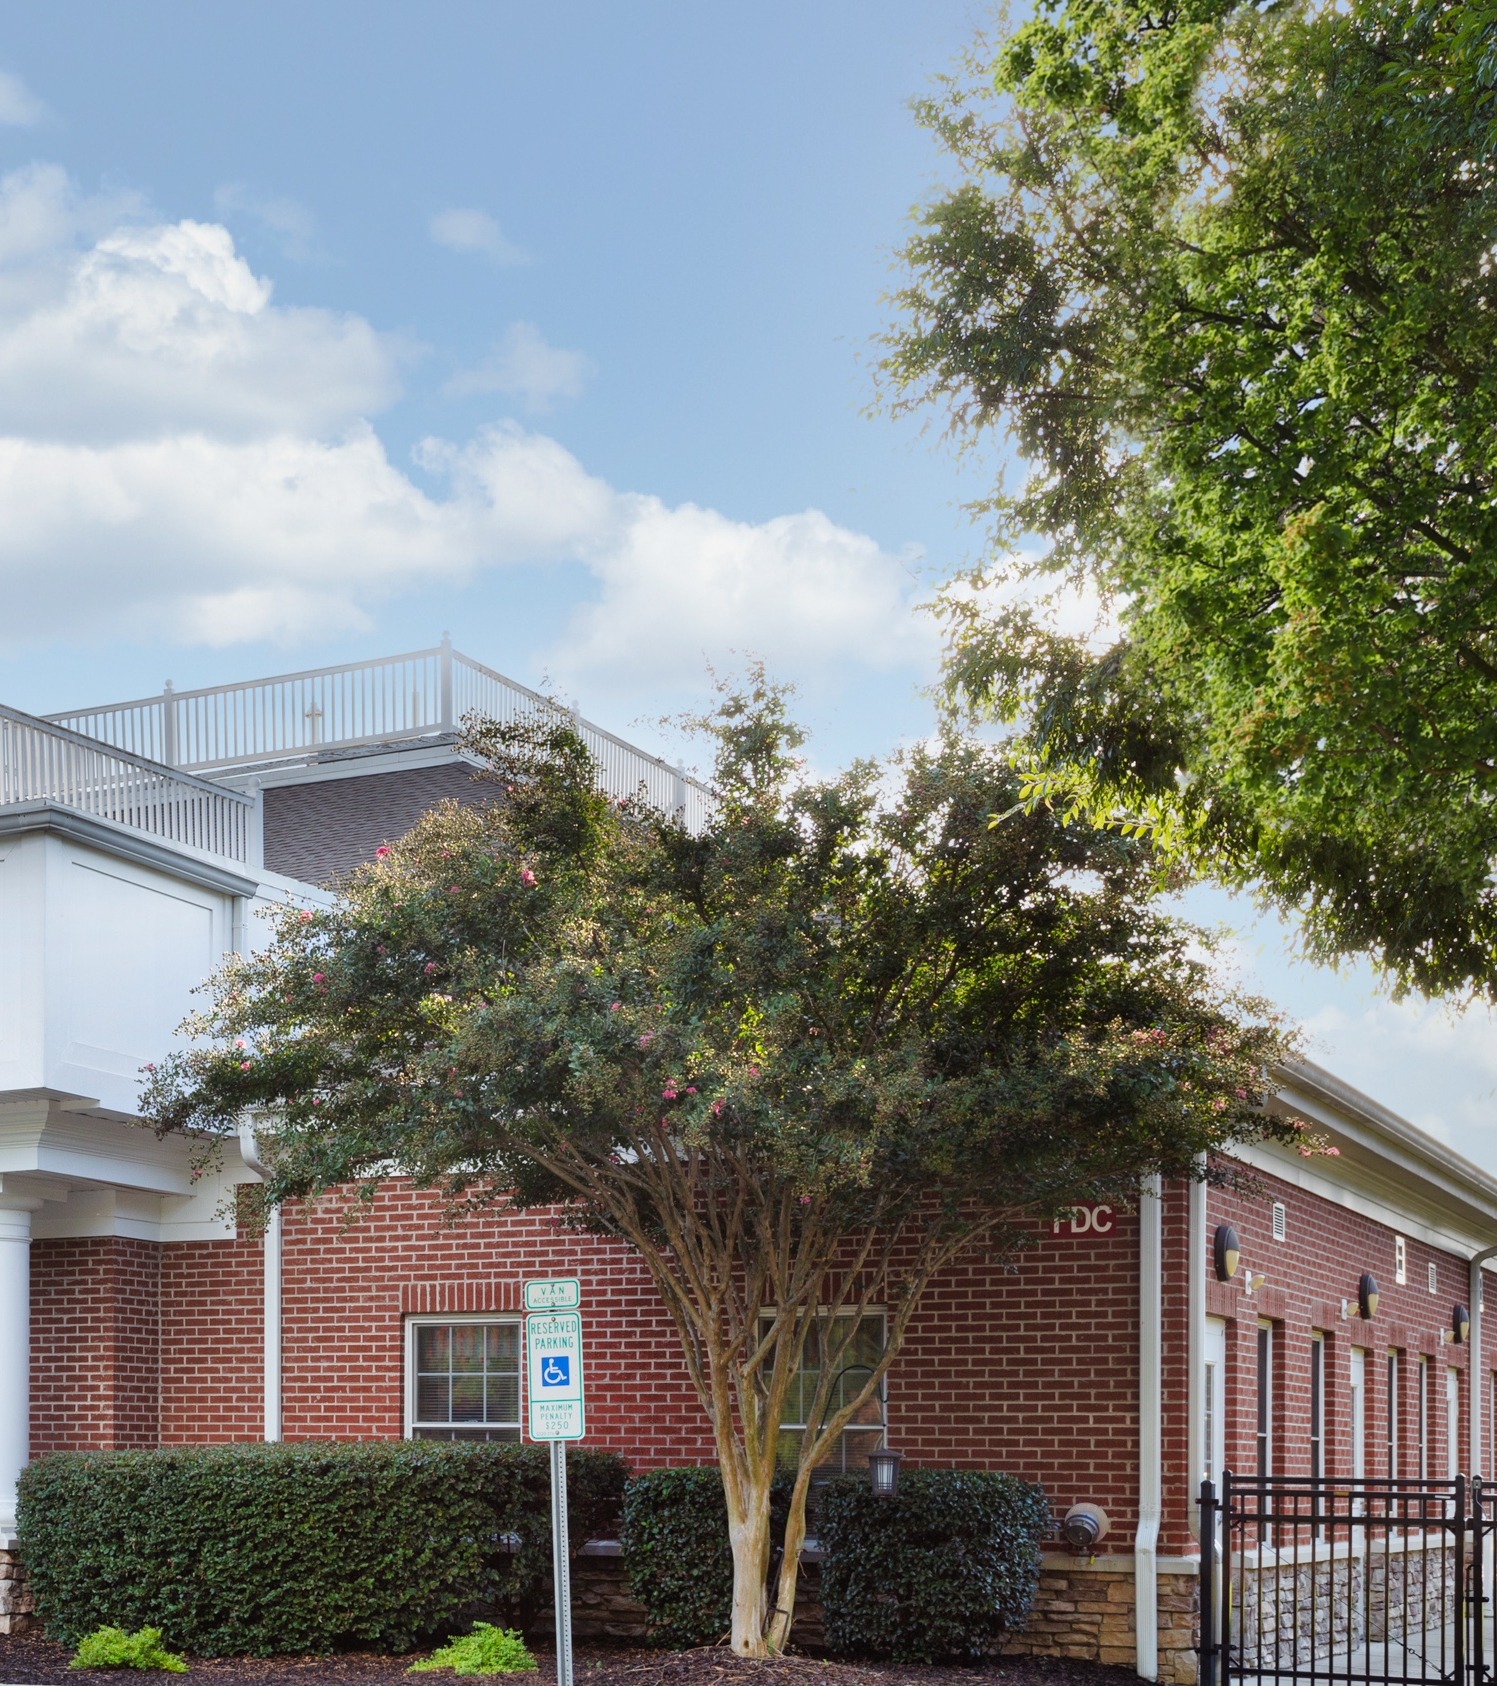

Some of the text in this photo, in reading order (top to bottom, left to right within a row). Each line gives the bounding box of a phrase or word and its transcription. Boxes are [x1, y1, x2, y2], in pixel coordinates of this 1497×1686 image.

[541, 1286, 565, 1296] VAN
[533, 1296, 572, 1304] ACCESSIBLE
[531, 1320, 577, 1335] RESERVED
[535, 1336, 574, 1350] PARKING
[540, 1404, 573, 1412] MAXIMUM
[540, 1412, 573, 1420] PENALTY
[545, 1421, 569, 1430] $250
